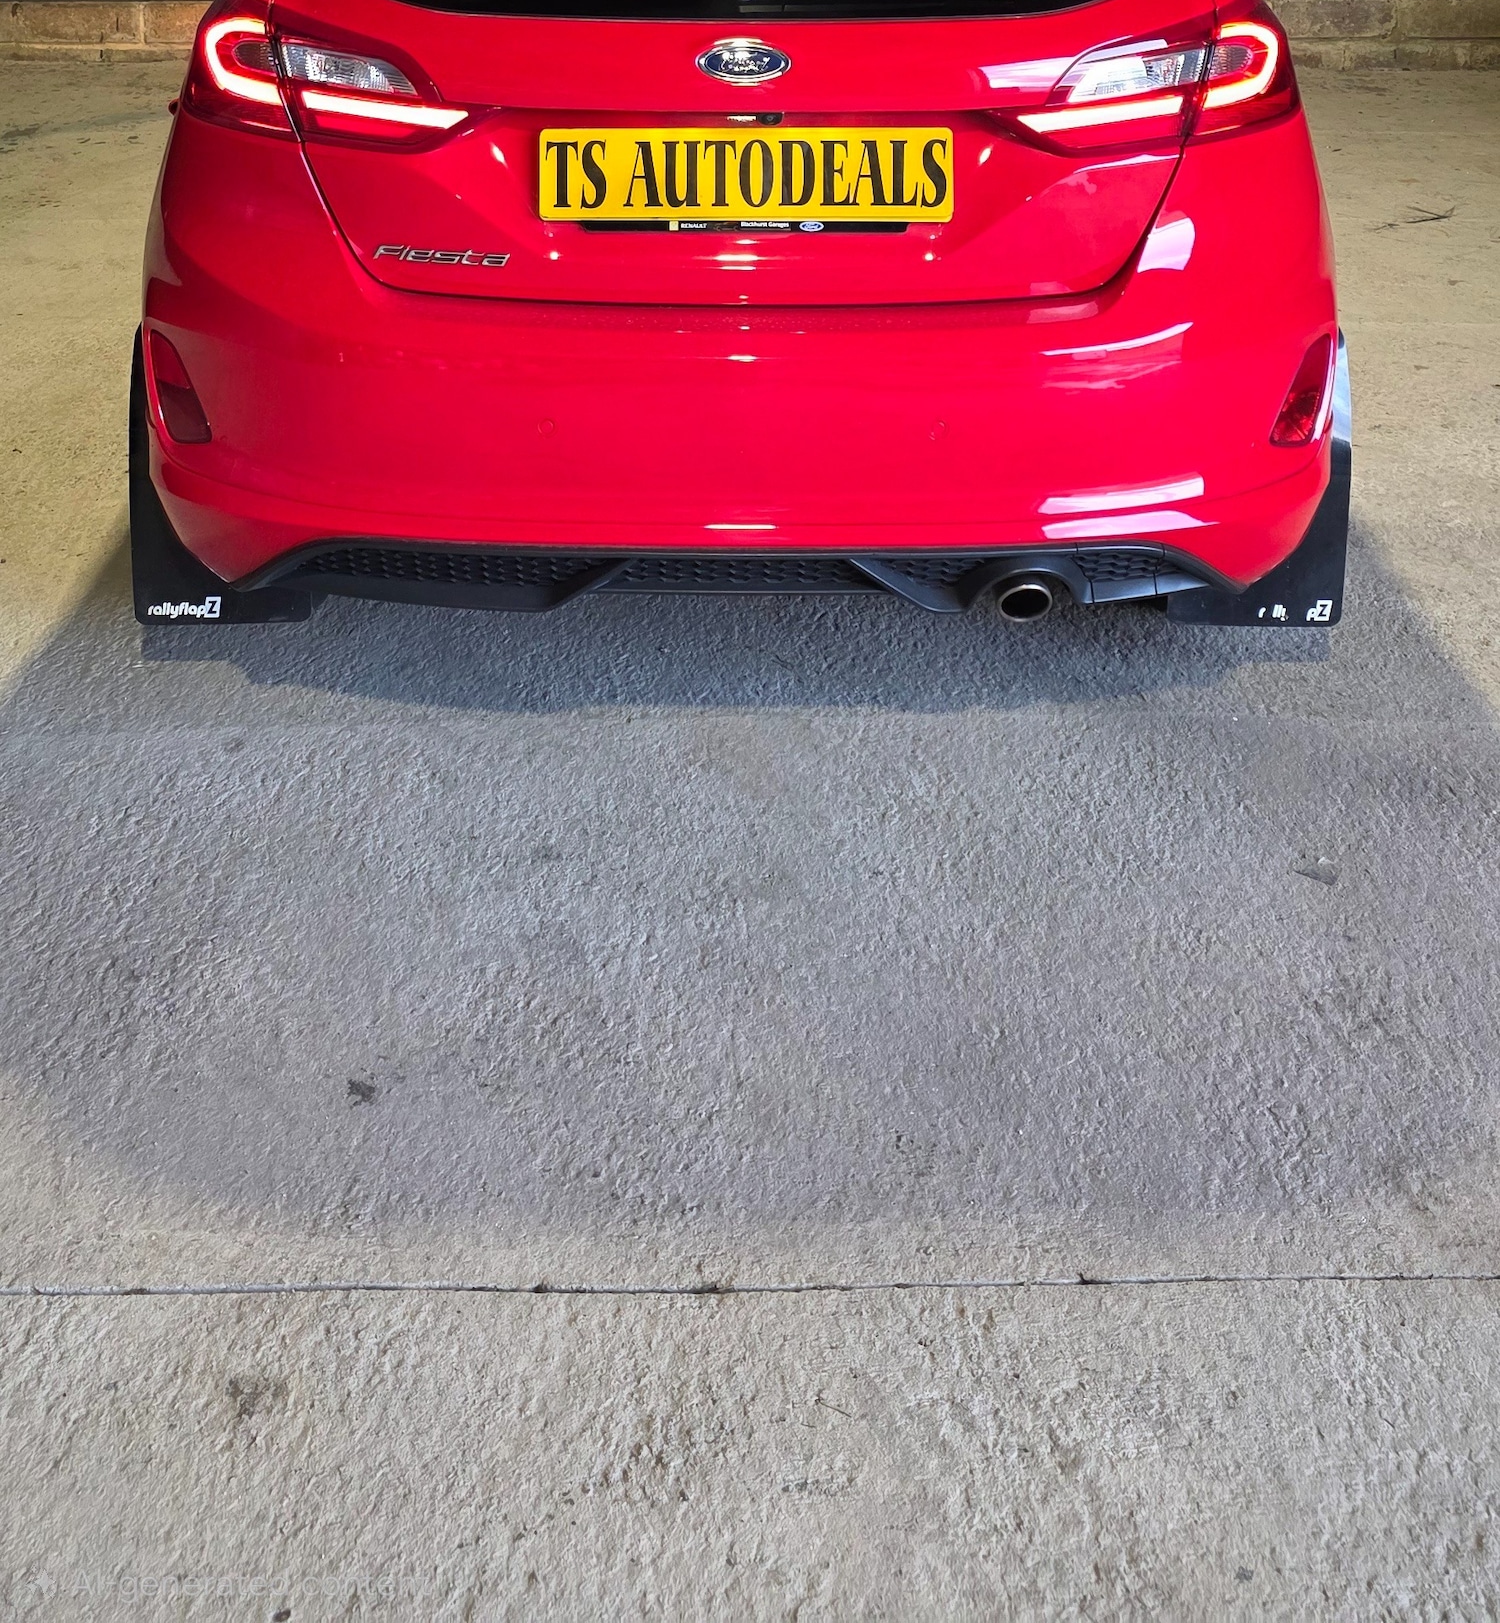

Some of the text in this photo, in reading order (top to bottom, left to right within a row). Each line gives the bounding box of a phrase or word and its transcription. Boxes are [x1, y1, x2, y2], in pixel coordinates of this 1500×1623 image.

[545, 138, 949, 210] TS AUTODEALS
[373, 245, 511, 267] Fiesta
